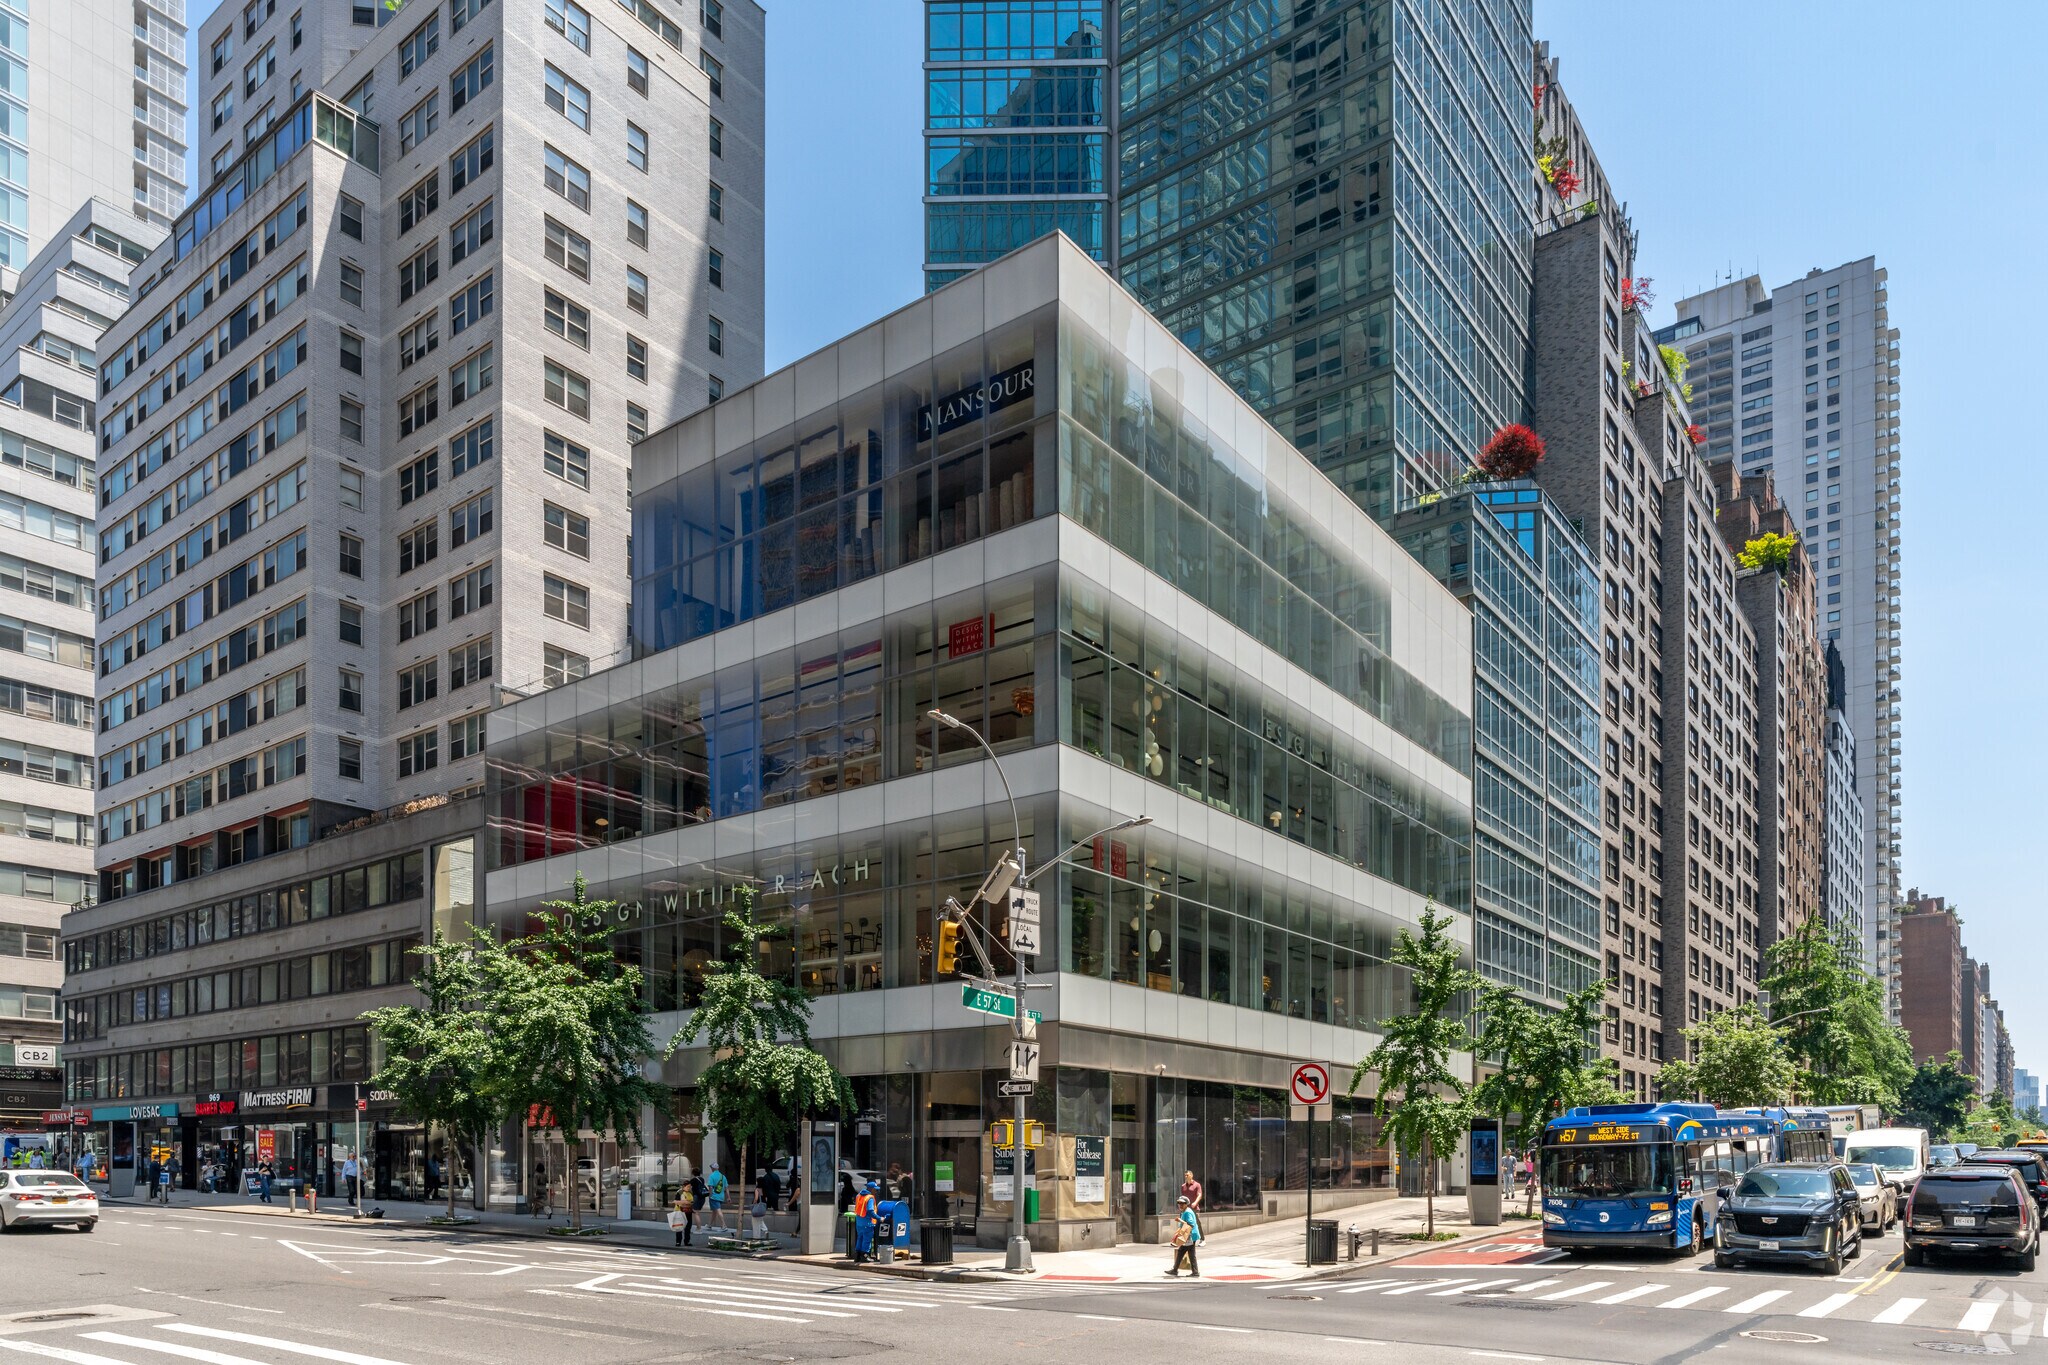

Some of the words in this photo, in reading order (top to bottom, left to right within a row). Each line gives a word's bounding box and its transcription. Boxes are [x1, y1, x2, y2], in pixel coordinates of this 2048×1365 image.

[923, 367, 1035, 432] MANSOUR
[775, 858, 870, 895] RACH
[1025, 897, 1039, 906] TRUCK
[1025, 907, 1039, 917] ROUTE
[1017, 924, 1033, 933] LOCAL
[976, 993, 982, 1007] E
[983, 995, 992, 1009] 57
[993, 997, 1001, 1011] St
[22, 1051, 49, 1061] CB2
[7, 1095, 26, 1103] CB2
[208, 1093, 221, 1102] 969
[129, 1105, 161, 1118] LOVESAC
[219, 1101, 236, 1115] SHOP
[1598, 1126, 1614, 1134] WEST
[1559, 1129, 1577, 1142] M57
[1588, 1132, 1630, 1141] BROADWAY-72
[1631, 1132, 1640, 1140] ST
[259, 1137, 274, 1147] SALE
[1077, 1138, 1087, 1149] For
[1076, 1148, 1102, 1160] Sublease
